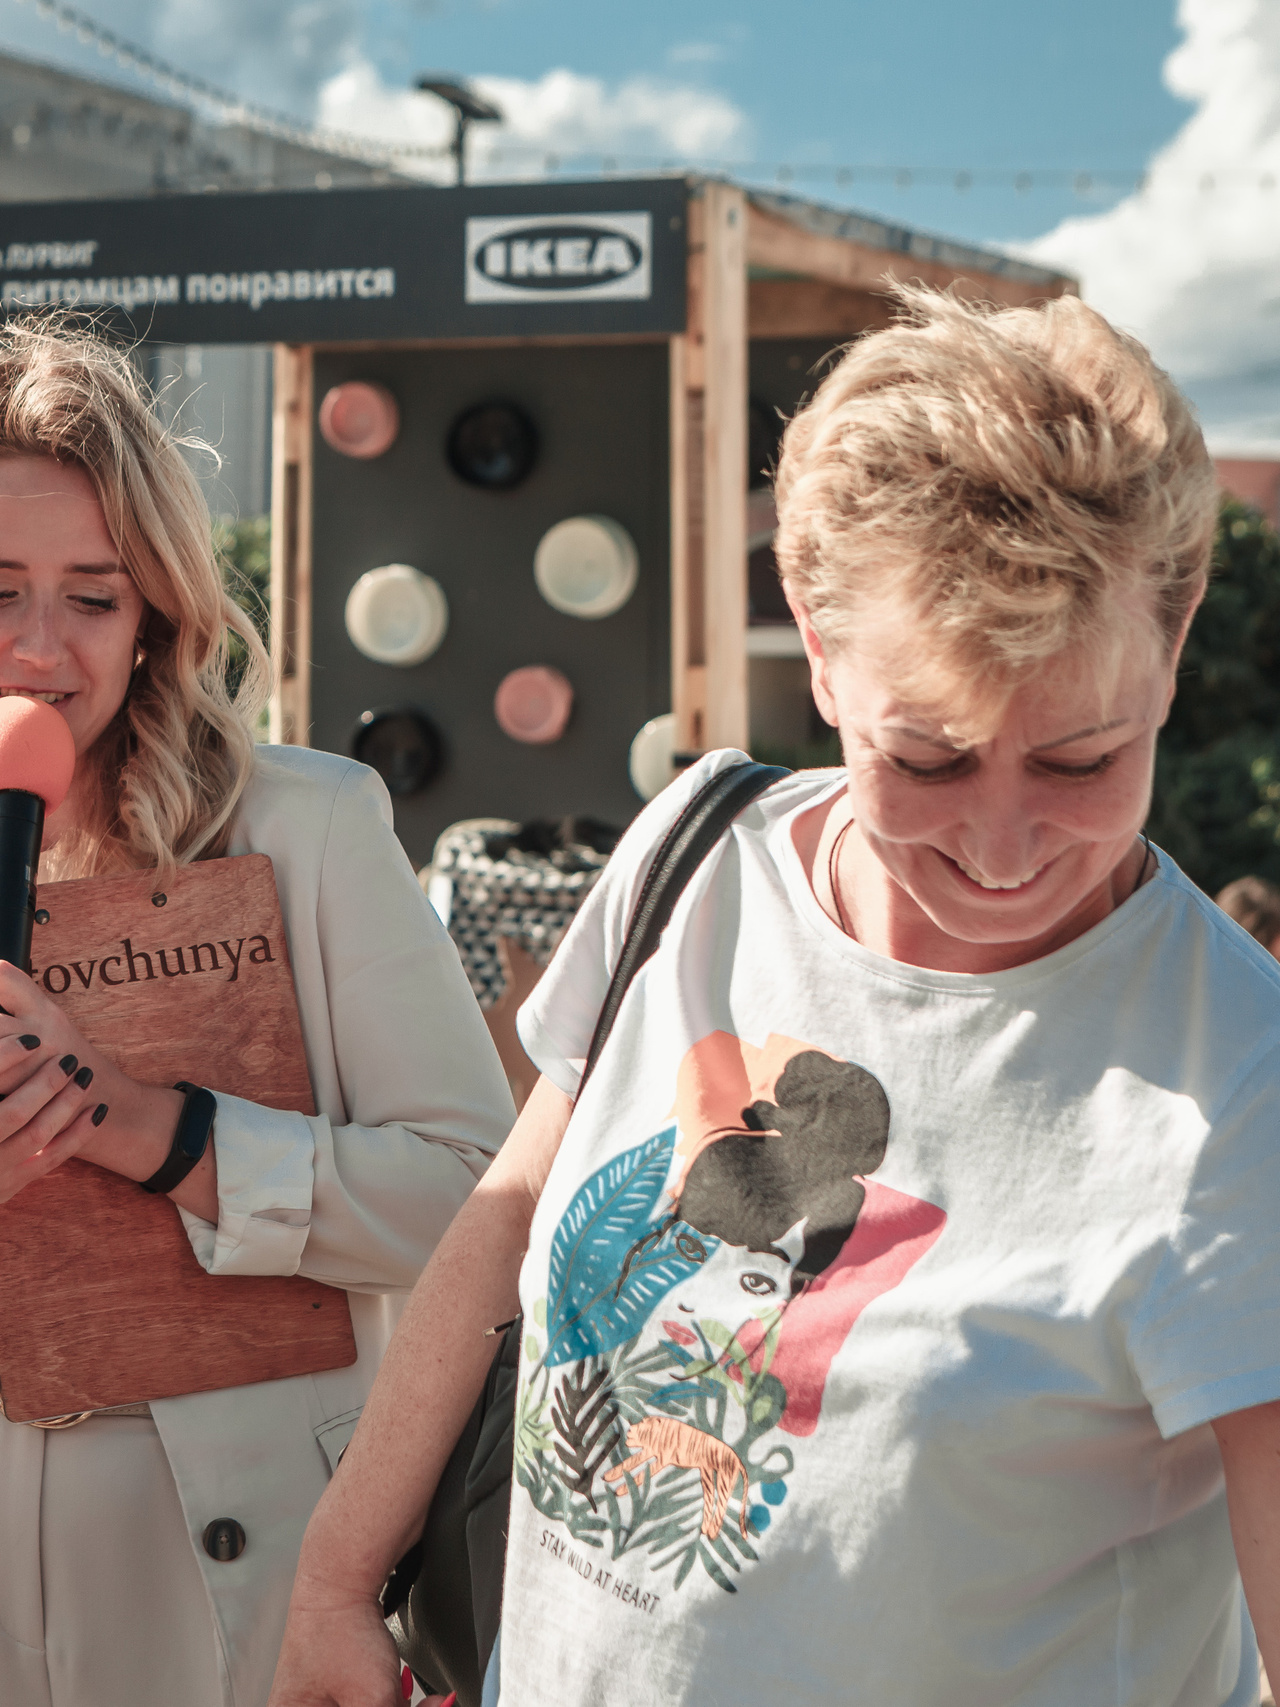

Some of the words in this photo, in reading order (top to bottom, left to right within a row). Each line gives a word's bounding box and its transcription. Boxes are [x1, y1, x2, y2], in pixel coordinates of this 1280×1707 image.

[484, 236, 636, 277] IKEA
[1, 276, 179, 312] питомцам
[186, 267, 396, 311] понравится
[540, 1529, 568, 1560] STAY
[567, 1547, 593, 1580] WILD
[593, 1568, 613, 1590] AT
[611, 1577, 661, 1615] HEART
